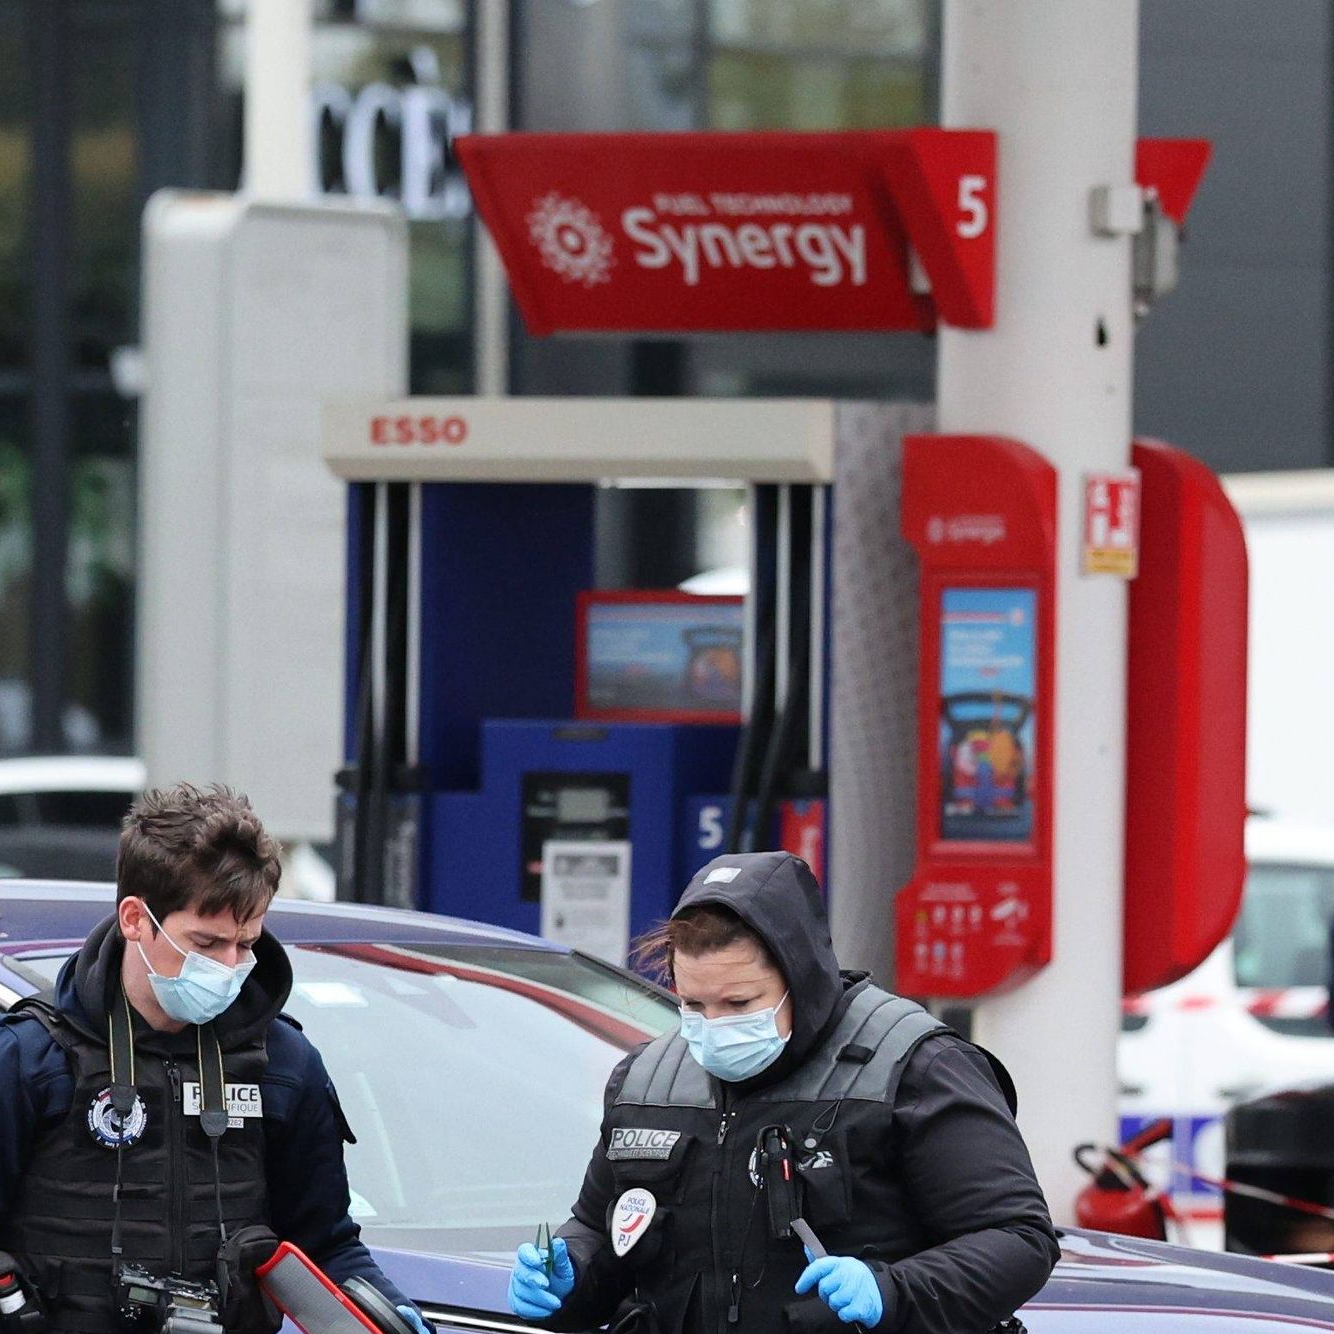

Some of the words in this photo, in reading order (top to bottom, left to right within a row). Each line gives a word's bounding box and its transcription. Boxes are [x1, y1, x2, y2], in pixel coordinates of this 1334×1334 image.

[956, 175, 988, 239] 5
[621, 205, 867, 287] Synergy
[370, 416, 468, 446] ESSO
[698, 805, 724, 850] 5
[192, 1086, 258, 1102] PICE
[611, 1129, 680, 1148] POLICE
[620, 1203, 650, 1215] NATIONALE
[627, 1196, 646, 1207] POLICE
[617, 1233, 631, 1247] PJ
